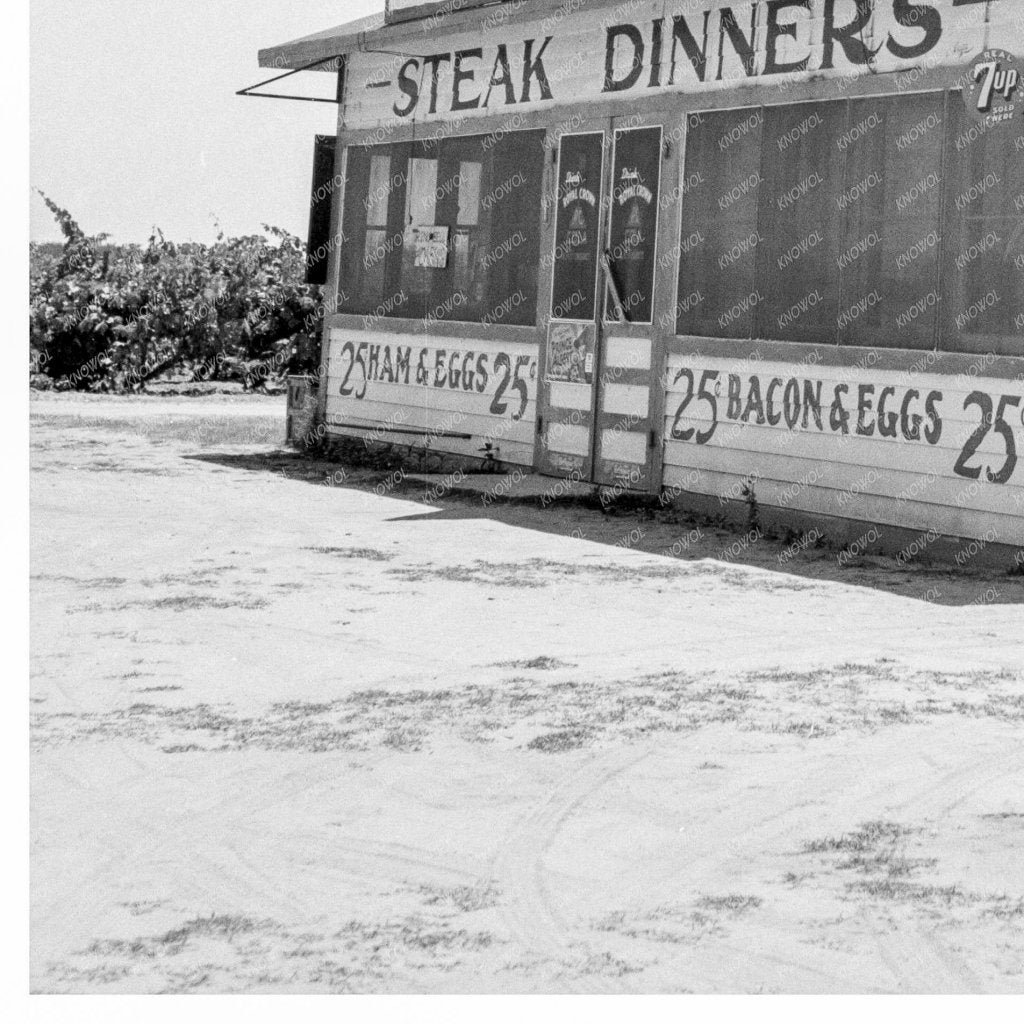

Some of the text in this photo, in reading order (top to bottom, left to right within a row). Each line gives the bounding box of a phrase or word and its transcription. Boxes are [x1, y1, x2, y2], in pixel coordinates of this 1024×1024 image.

[392, 36, 556, 119] STEAK
[984, 50, 1013, 62] REAL
[368, 344, 412, 384] HAM
[416, 347, 429, 386] &
[434, 349, 488, 393] EGGS
[726, 373, 823, 432] BACON
[829, 383, 850, 436] &
[856, 383, 943, 445] EGGS
